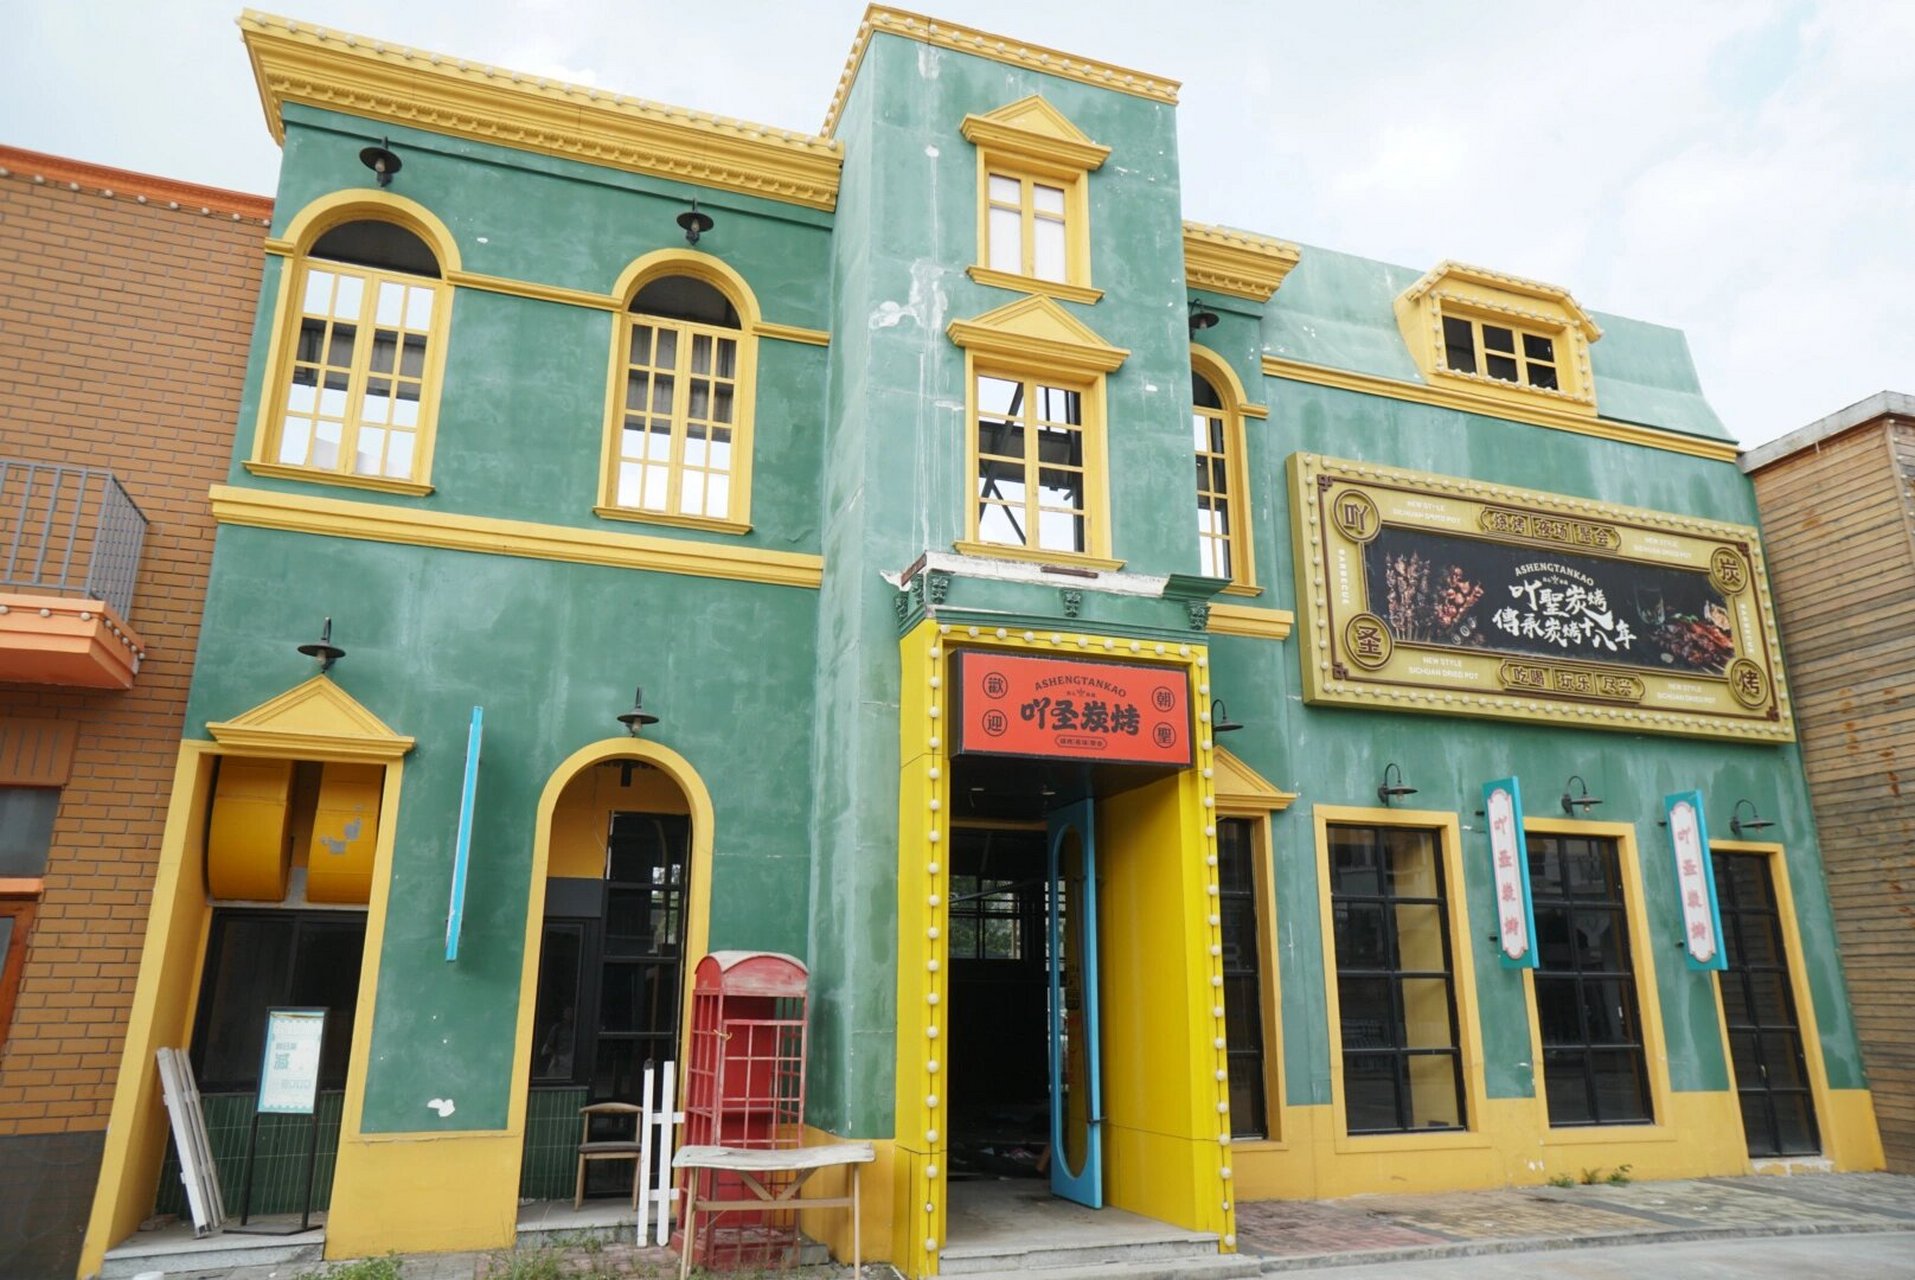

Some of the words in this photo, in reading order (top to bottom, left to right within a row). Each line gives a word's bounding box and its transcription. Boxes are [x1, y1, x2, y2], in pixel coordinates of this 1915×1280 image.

[1343, 503, 1369, 531] 吖
[1538, 519, 1568, 541] 夜场
[1514, 562, 1595, 587] ASHENGTANKAO
[1719, 557, 1741, 583] 炭
[1357, 625, 1383, 656] 圣
[1491, 605, 1638, 652] 傳承炭烤十八年
[1034, 675, 1128, 698] ASHENGTANKAO
[1512, 666, 1545, 687] 吃喝
[1560, 672, 1591, 692] 玩乐
[1603, 675, 1633, 697] 尽兴
[1740, 669, 1761, 695] 烤
